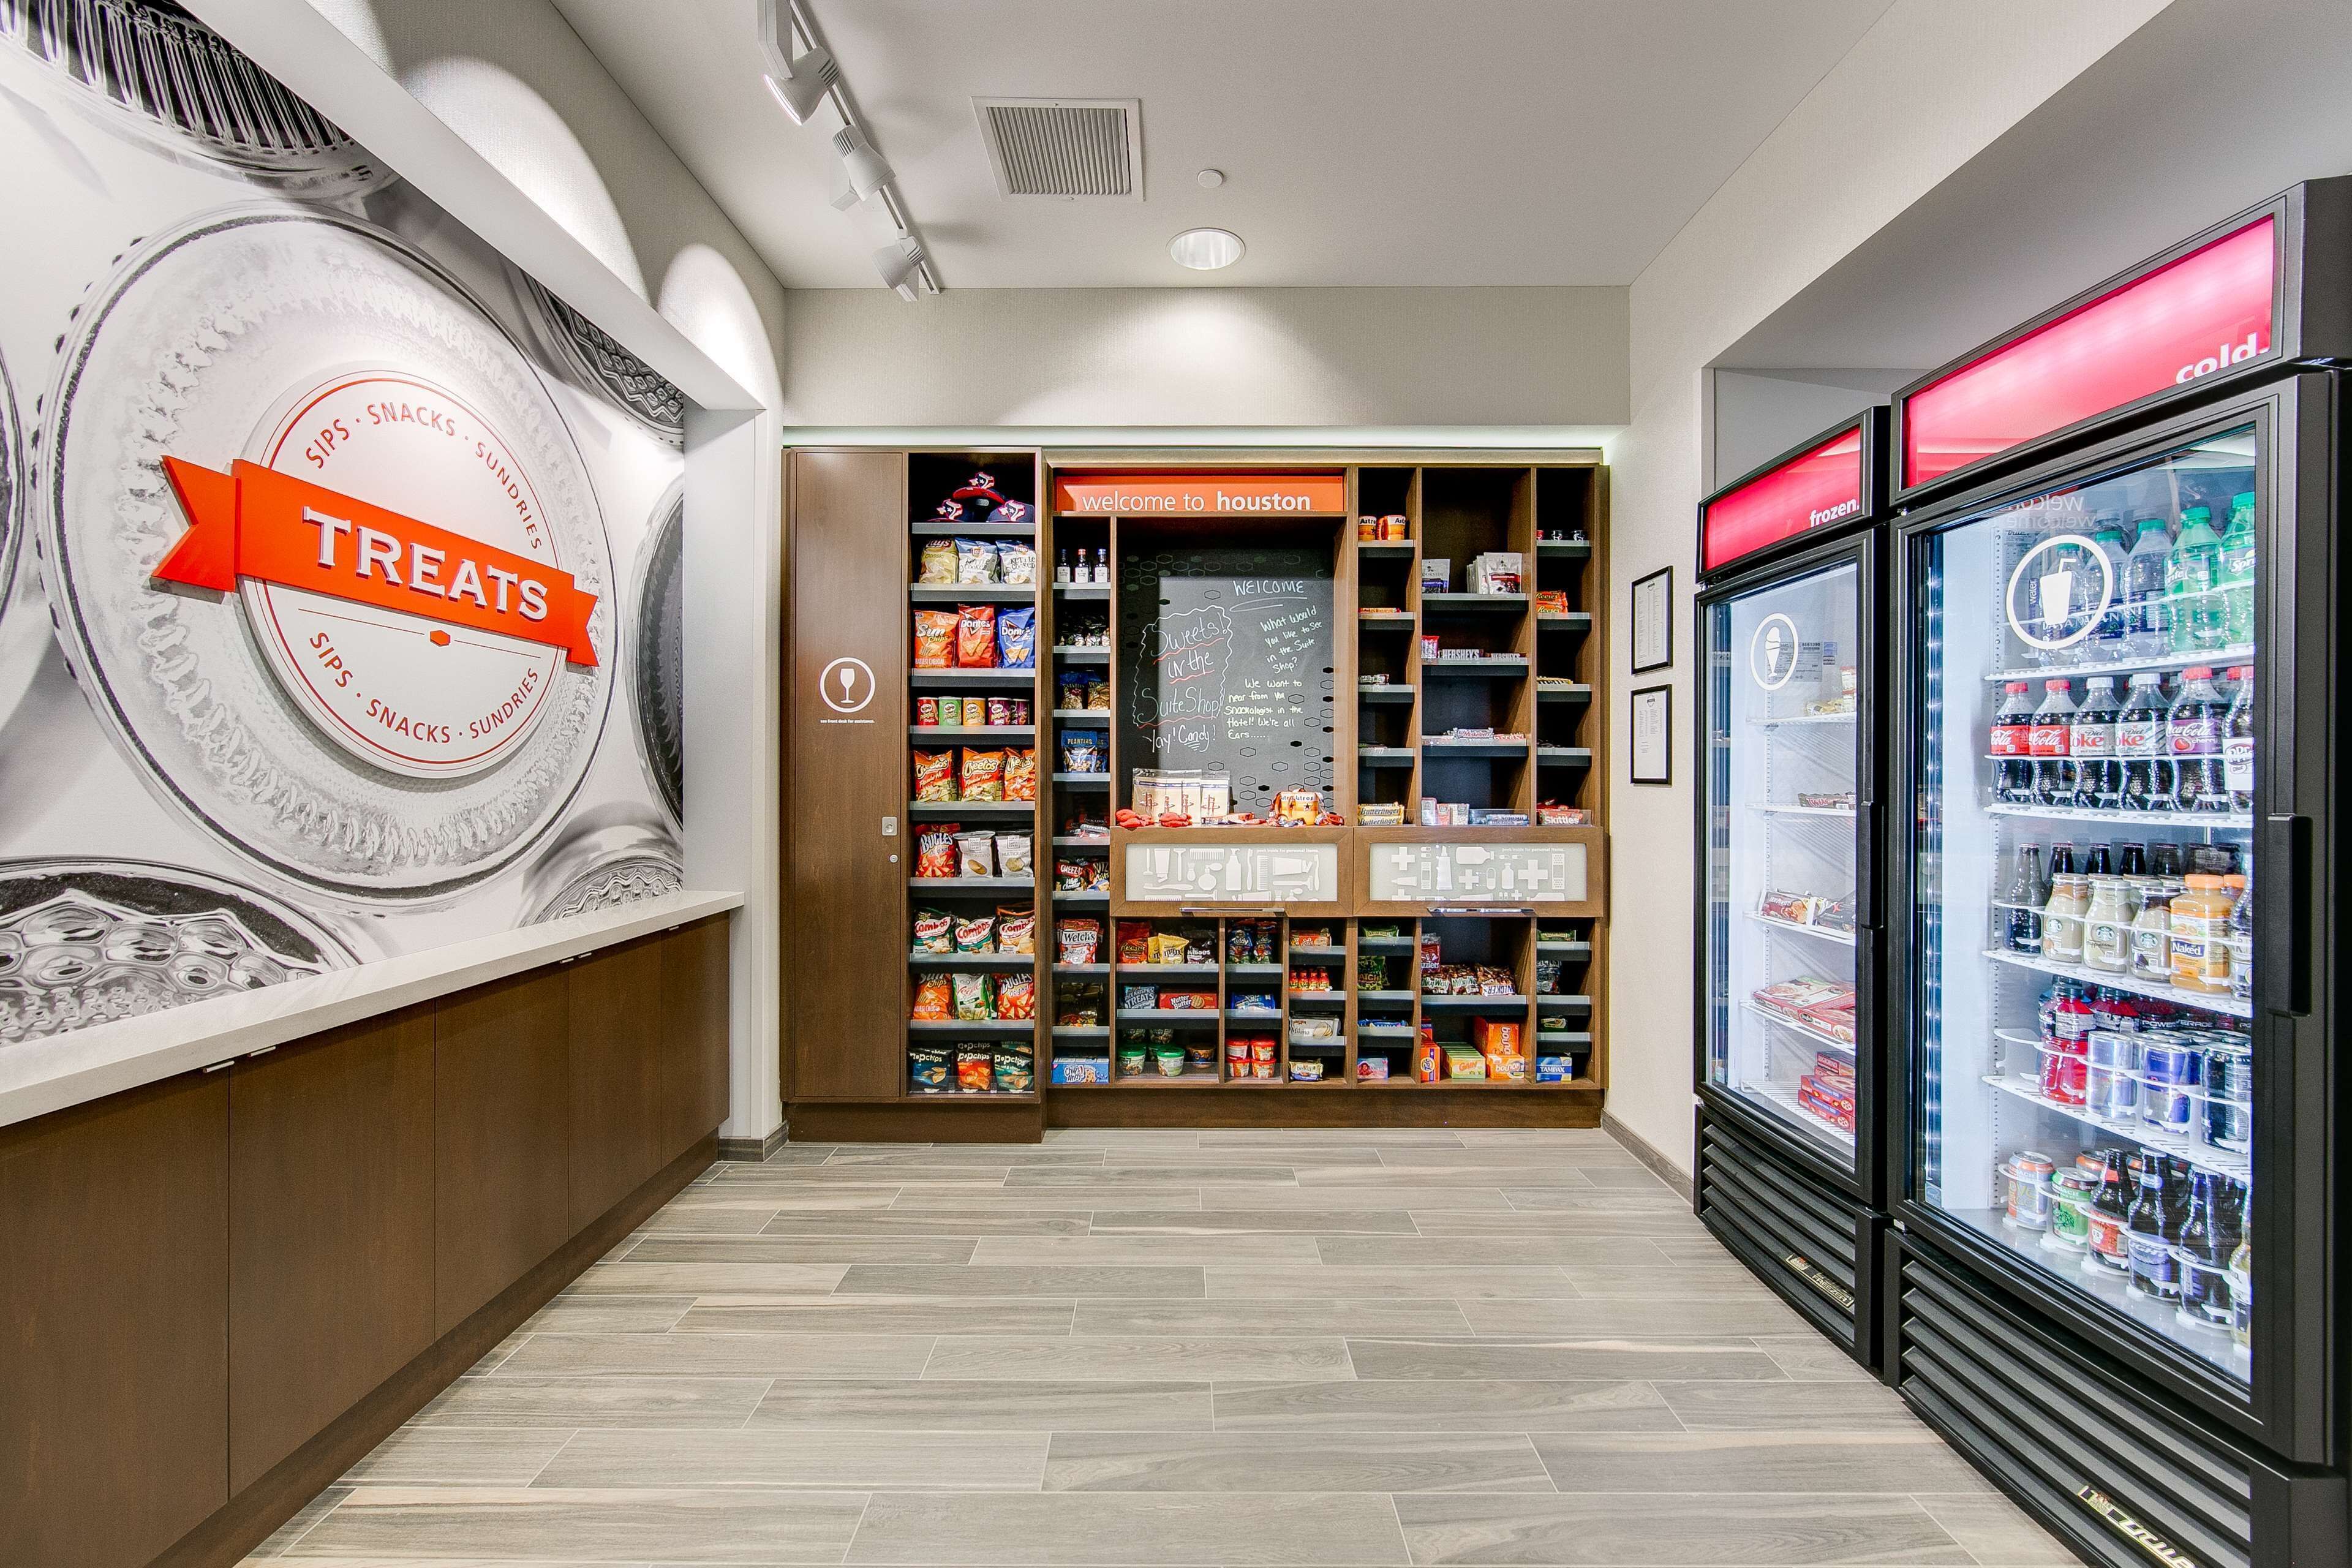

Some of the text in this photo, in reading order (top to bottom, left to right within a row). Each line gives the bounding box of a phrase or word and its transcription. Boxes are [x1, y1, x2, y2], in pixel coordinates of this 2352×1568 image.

[2176, 333, 2269, 384] cold.
[306, 402, 542, 550] SIPS SNACKS SUNDRIES
[1082, 490, 1311, 511] welcome to houston
[1809, 499, 1860, 527] frozen.
[303, 506, 548, 622] TREATS
[917, 624, 946, 637] Sun
[1260, 617, 1286, 631] What
[1150, 612, 1227, 657] Sweets!
[1283, 631, 1298, 639] like
[1279, 647, 1294, 655] the
[1294, 638, 1315, 651] Suite
[1442, 649, 1479, 660] HERSHEY'S
[1187, 650, 1214, 675] the
[309, 632, 538, 744] SIPS SNACKS SUNDRIES
[1245, 679, 1261, 688] We
[1249, 690, 1268, 700] from
[1227, 717, 1254, 728] Hotel!
[1142, 725, 1216, 753] Yay! Candy!
[963, 760, 997, 778] Cheetos
[921, 833, 954, 854] BUGLES
[915, 919, 948, 933] Combos
[957, 921, 990, 939] Combos
[1002, 918, 1035, 932] Combos
[1064, 932, 1095, 943] Welch's
[1126, 993, 1154, 1009] TREATS
[1174, 1000, 1192, 1009] Butter
[1291, 1027, 1310, 1035] Milano
[957, 1052, 990, 1061] popchips
[994, 1054, 1026, 1066] popchips
[1065, 1066, 1080, 1076] Chips
[1812, 1274, 1849, 1302] FREEZER
